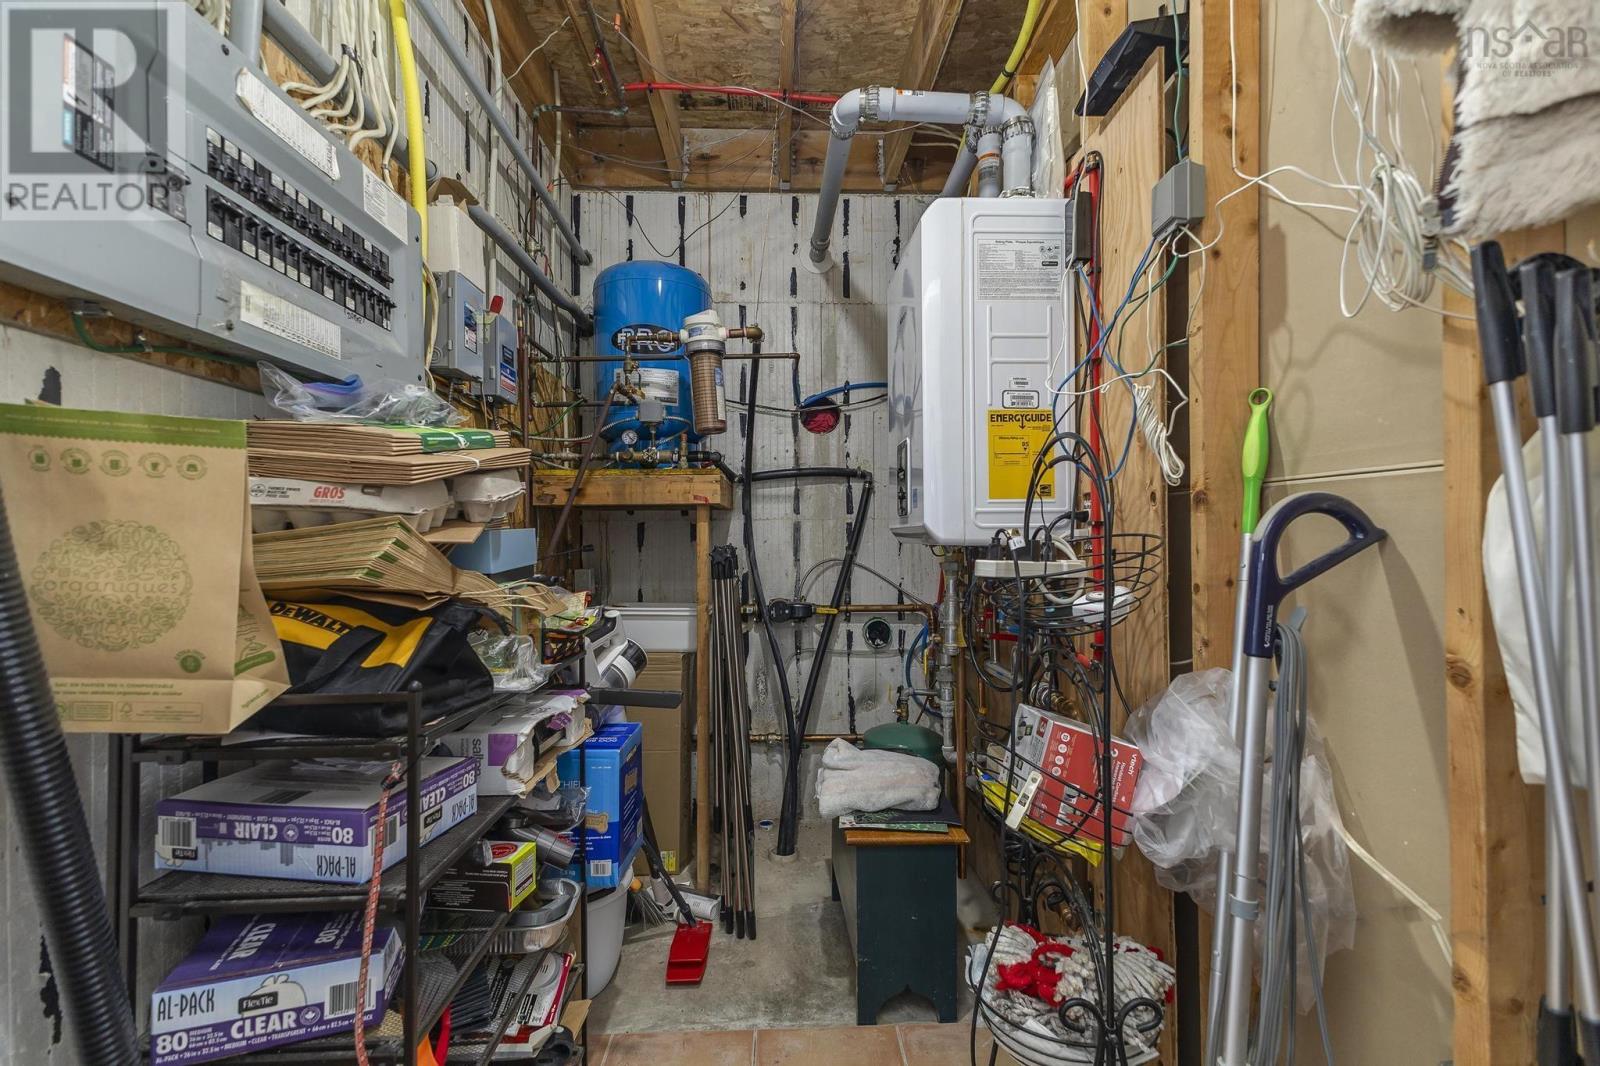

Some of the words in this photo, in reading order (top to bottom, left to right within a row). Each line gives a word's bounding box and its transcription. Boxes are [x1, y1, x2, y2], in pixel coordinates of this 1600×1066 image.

[313, 486, 346, 499] GROS
[43, 580, 178, 599] organiques
[234, 822, 278, 841] CLAIR
[331, 827, 354, 845] 80
[316, 854, 357, 878] AL-PACK
[157, 988, 215, 1022] AL-PACK
[230, 1010, 298, 1039] CLEAR
[156, 1031, 189, 1056] 80
